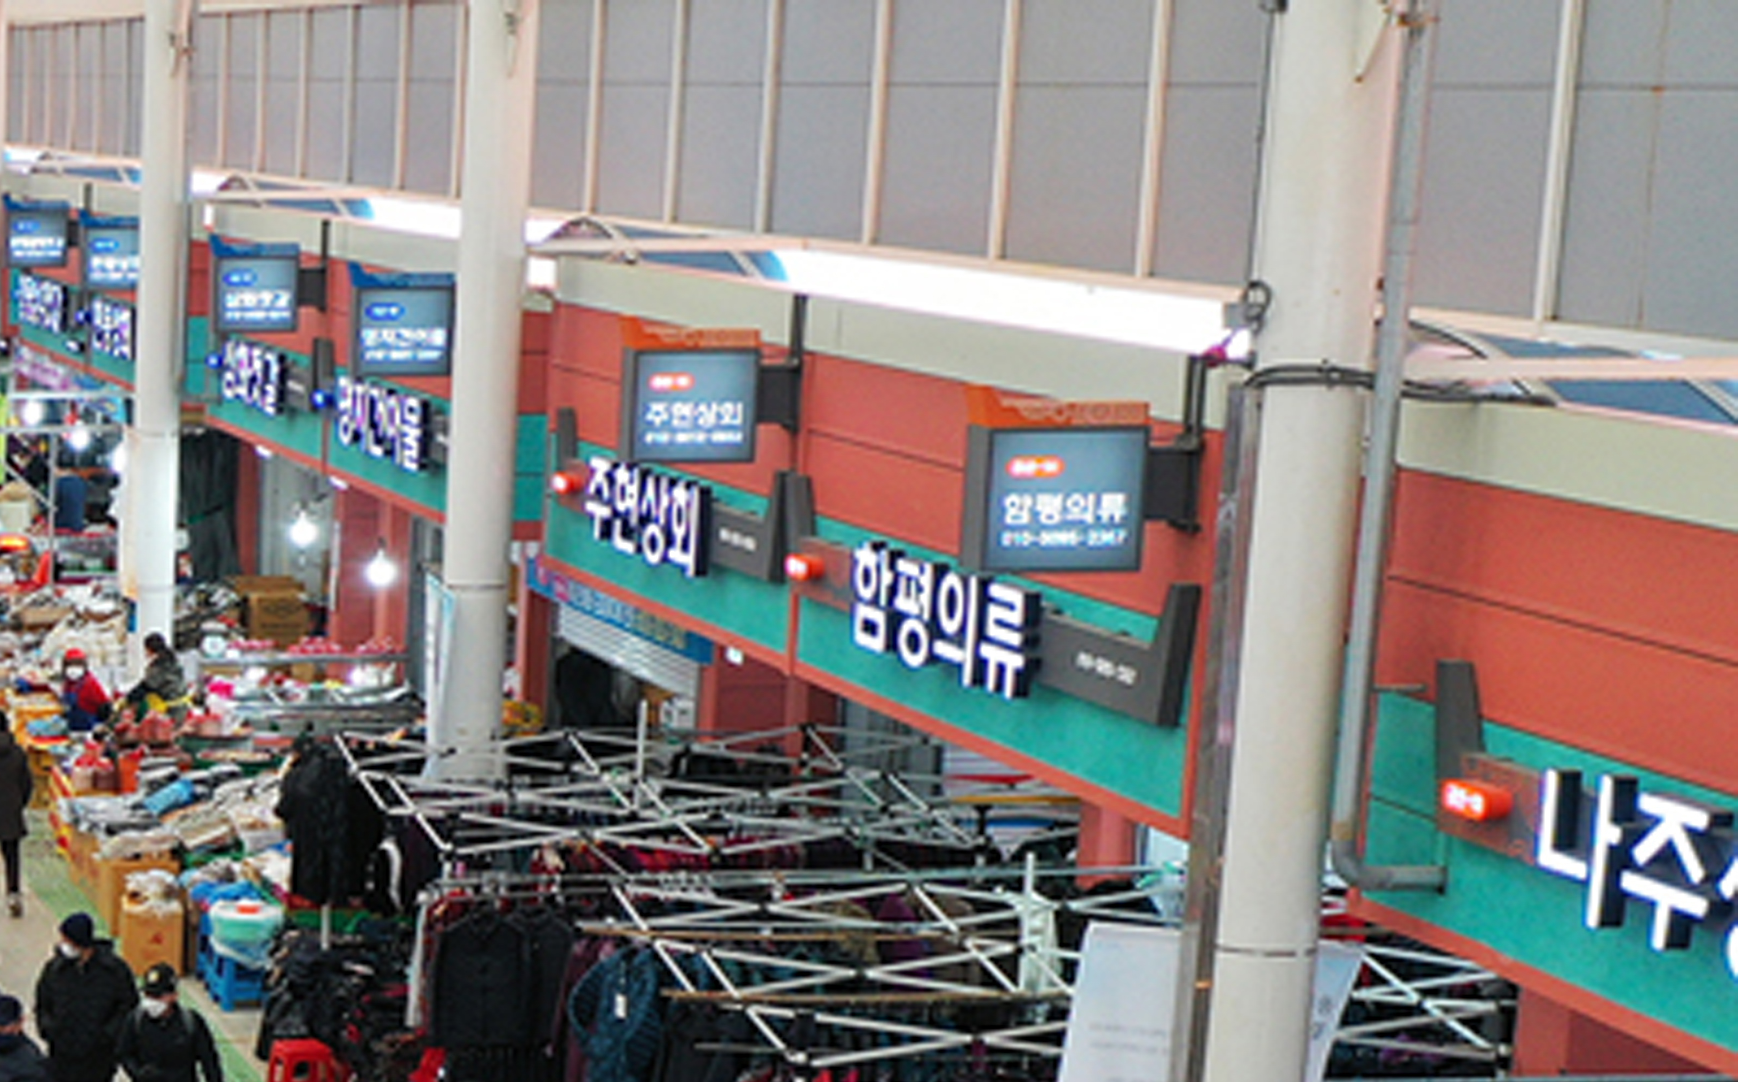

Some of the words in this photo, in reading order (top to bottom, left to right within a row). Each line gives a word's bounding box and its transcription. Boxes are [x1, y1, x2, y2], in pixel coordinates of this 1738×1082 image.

[585, 456, 700, 577] 주현상회
[1004, 492, 1127, 523] 함평의류
[851, 542, 1026, 699] 함평의류
[1537, 767, 1738, 982] 나주
